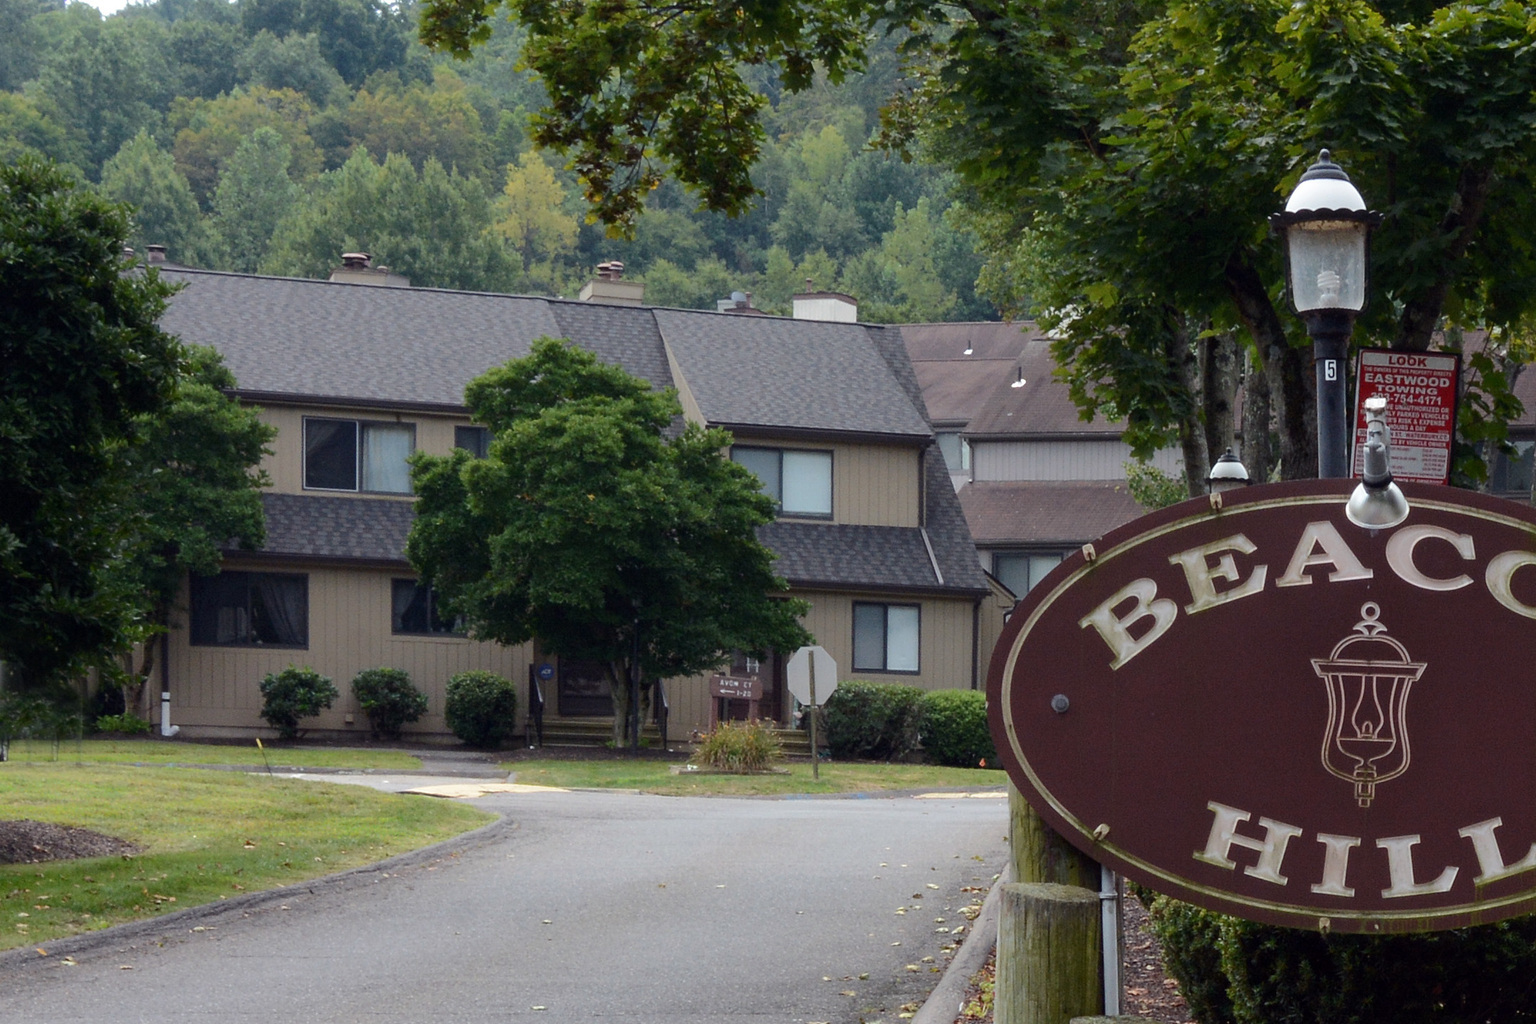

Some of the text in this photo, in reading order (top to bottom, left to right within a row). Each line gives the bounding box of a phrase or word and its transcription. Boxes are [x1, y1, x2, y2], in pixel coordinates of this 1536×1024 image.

[1388, 355, 1428, 367] LOOK
[1327, 361, 1336, 380] 5
[1364, 372, 1450, 388] EASTWOOD
[1375, 384, 1438, 396] TOWING
[1395, 404, 1440, 413] UNAUTHORIZED
[1397, 410, 1420, 418] PARKED
[1421, 412, 1449, 420] VEHICLES
[1419, 419, 1446, 427] EXPENSE
